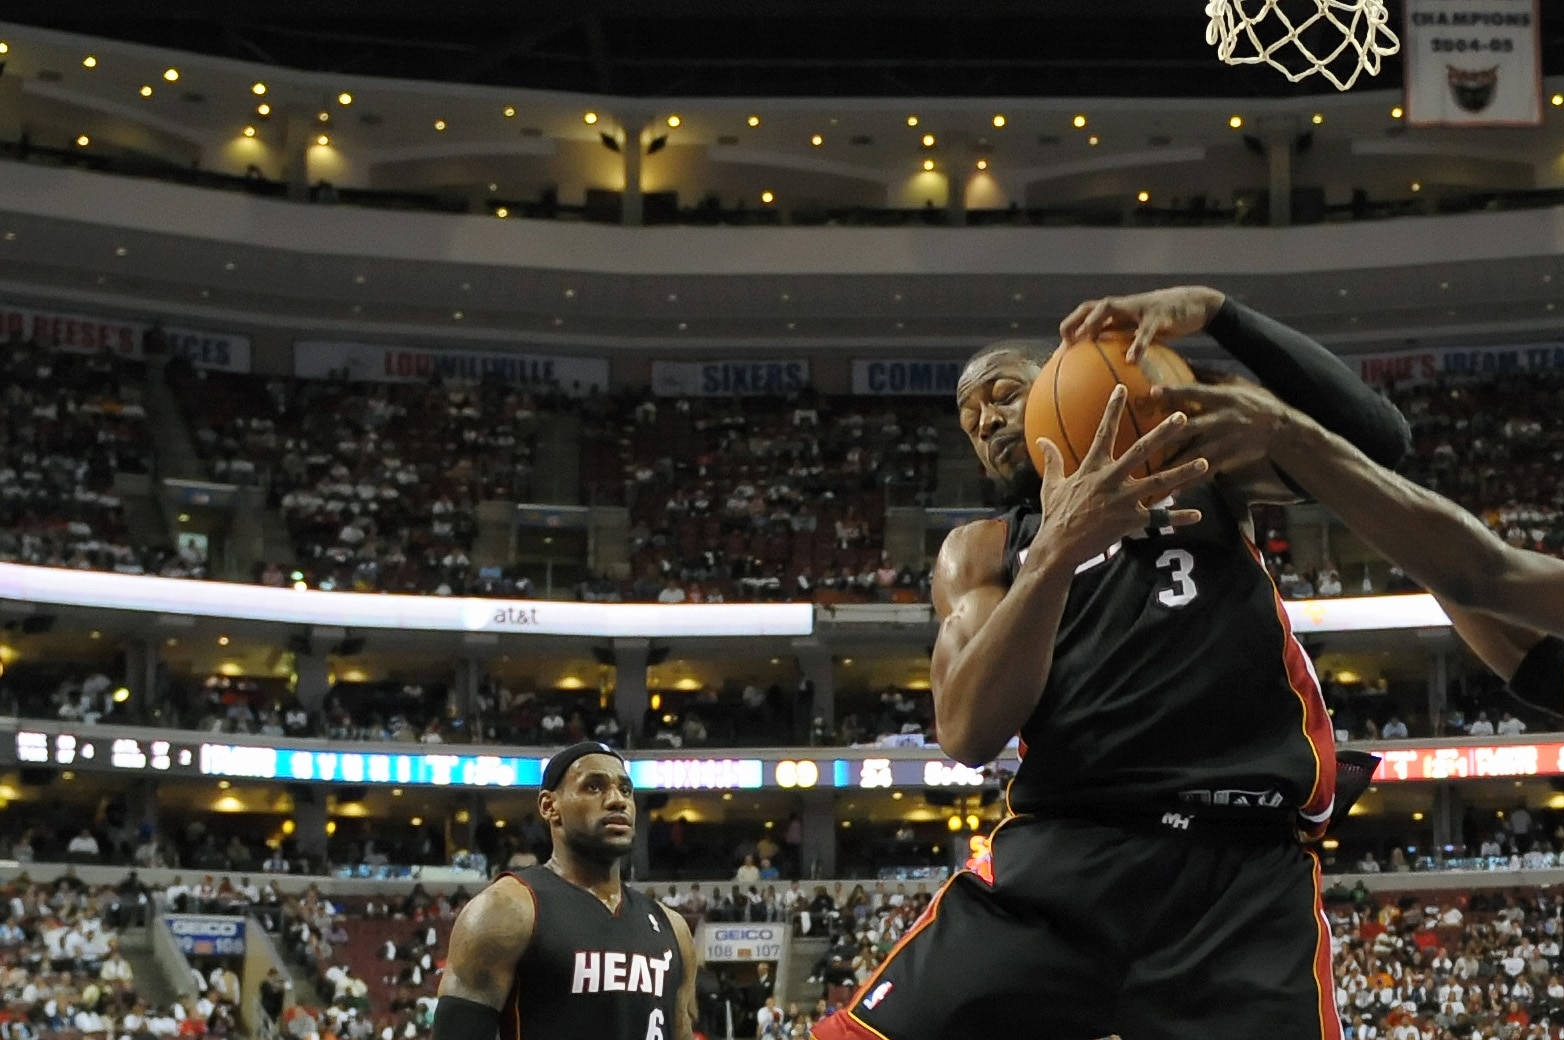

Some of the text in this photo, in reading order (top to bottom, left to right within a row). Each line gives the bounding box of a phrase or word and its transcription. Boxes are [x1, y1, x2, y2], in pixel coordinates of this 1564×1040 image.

[1411, 12, 1531, 27] CHAMPIONS
[702, 362, 803, 395] SIXERS
[867, 362, 959, 393] COMM
[1155, 548, 1198, 608] 3
[493, 607, 539, 625] at&t
[715, 929, 774, 942] GEICO
[708, 944, 780, 958] 108 107
[571, 948, 673, 998] HEAT
